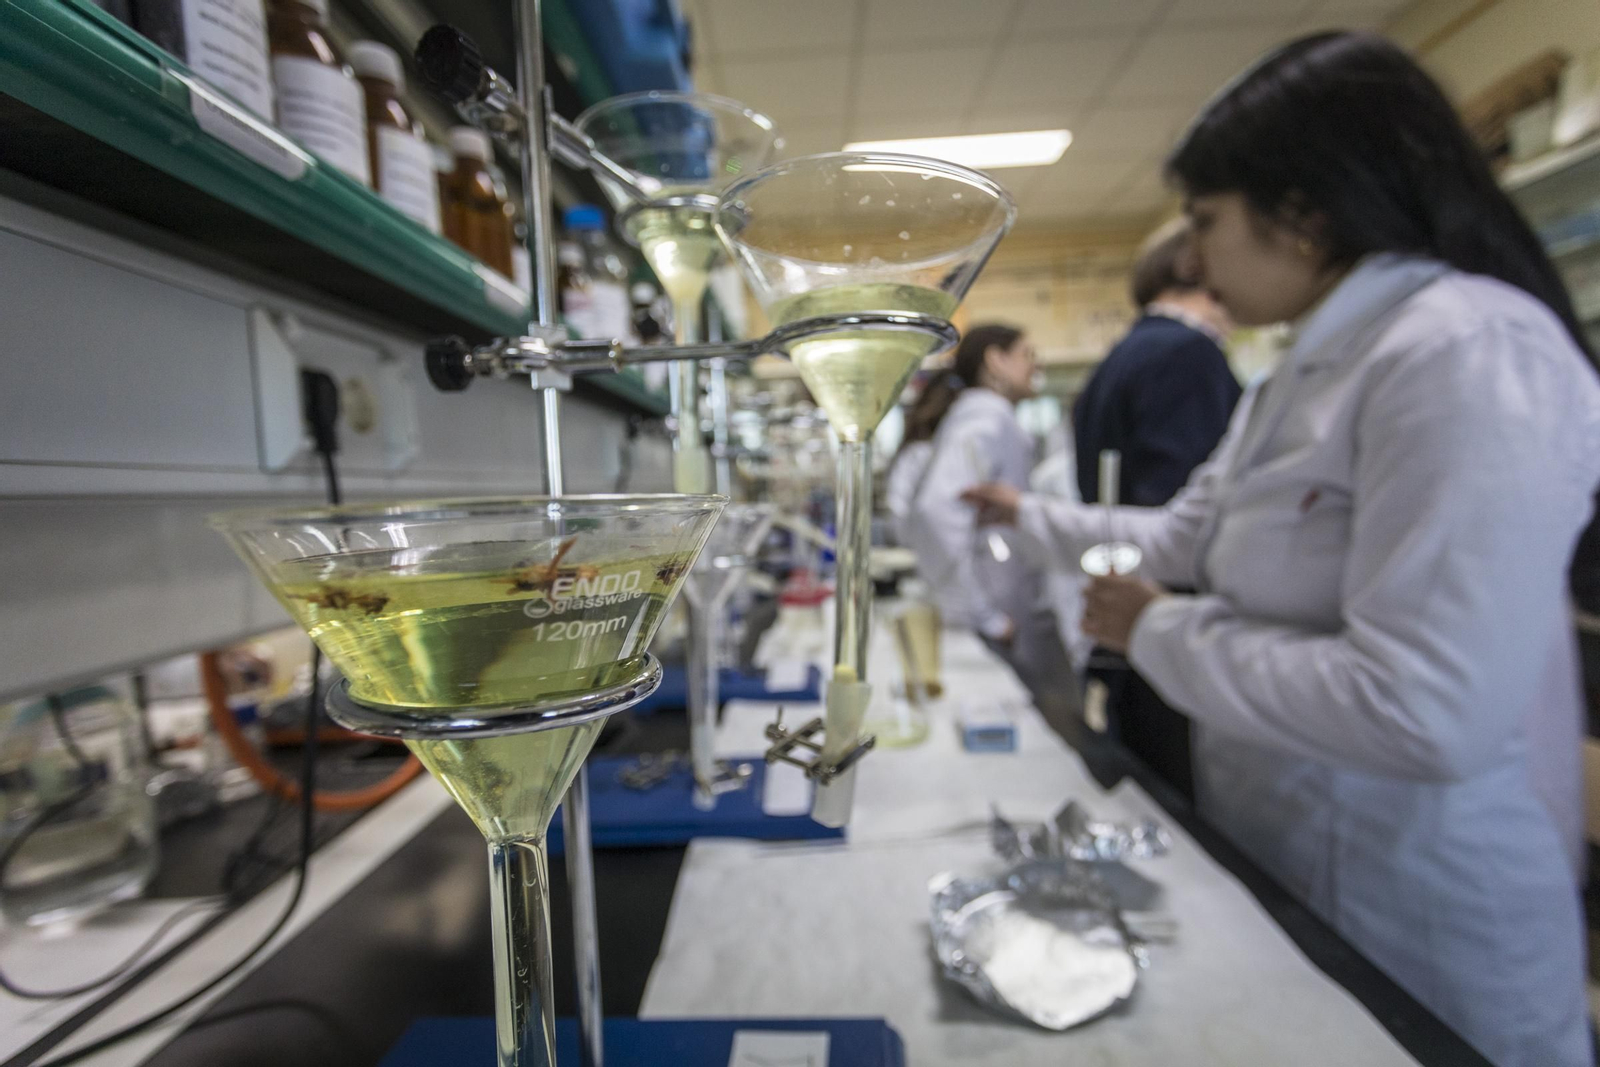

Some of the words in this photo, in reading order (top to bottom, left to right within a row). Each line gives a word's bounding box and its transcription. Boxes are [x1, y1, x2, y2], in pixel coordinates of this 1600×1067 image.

[551, 570, 641, 600] ENDO
[553, 588, 643, 614] glassware
[533, 615, 627, 642] 120mm
